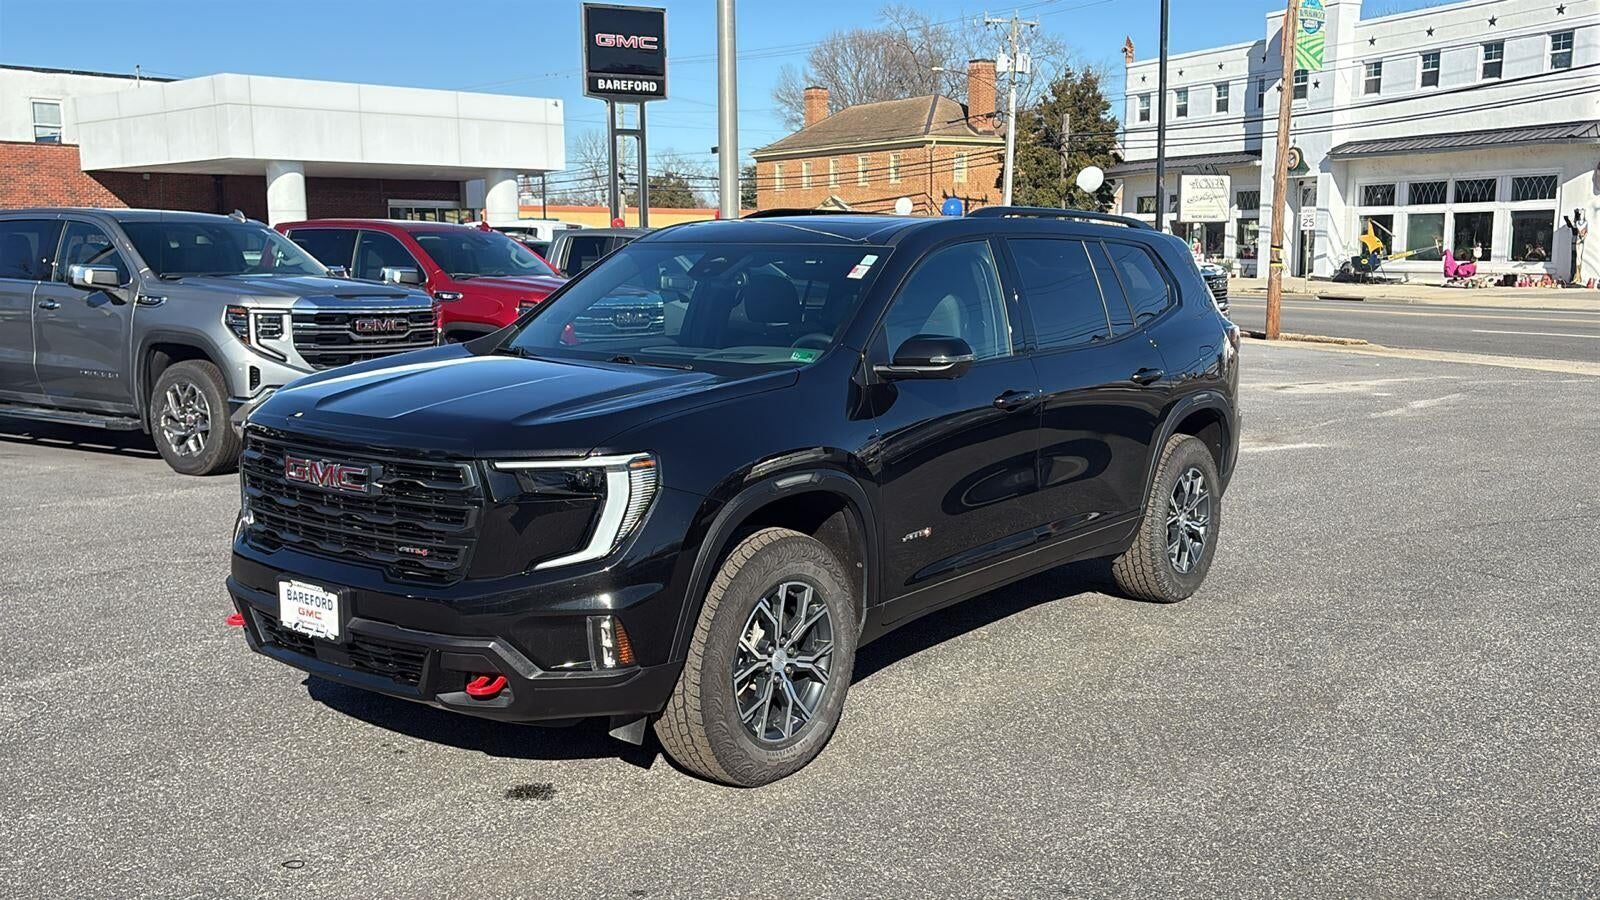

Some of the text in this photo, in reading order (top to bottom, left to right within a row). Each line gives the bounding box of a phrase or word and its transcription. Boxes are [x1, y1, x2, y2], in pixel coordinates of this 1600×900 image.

[595, 33, 658, 50] GMC
[597, 79, 657, 92] BAREFORD
[1302, 218, 1315, 227] 25
[355, 318, 408, 332] GMC
[284, 455, 369, 493] GMC
[286, 589, 334, 611] BAREFORD
[298, 607, 322, 620] GMC
